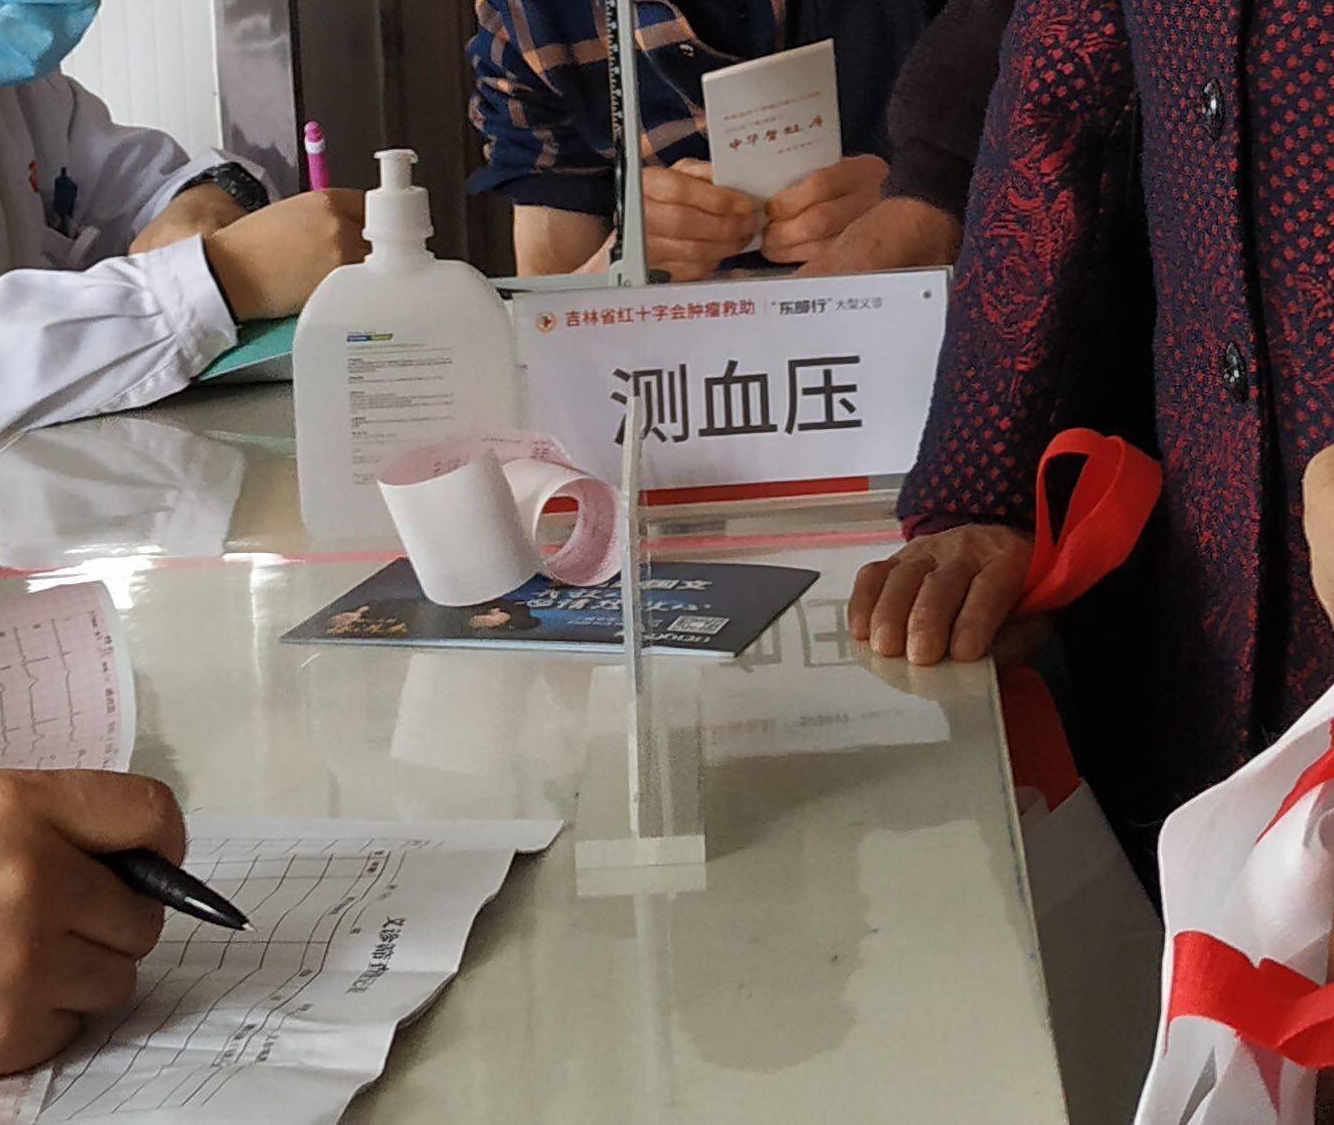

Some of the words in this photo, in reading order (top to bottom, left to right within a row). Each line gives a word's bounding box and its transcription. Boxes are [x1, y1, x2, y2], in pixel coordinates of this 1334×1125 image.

[566, 299, 756, 327] 吉林省红十字会肿瘤救助
[610, 355, 863, 446] 测血压
